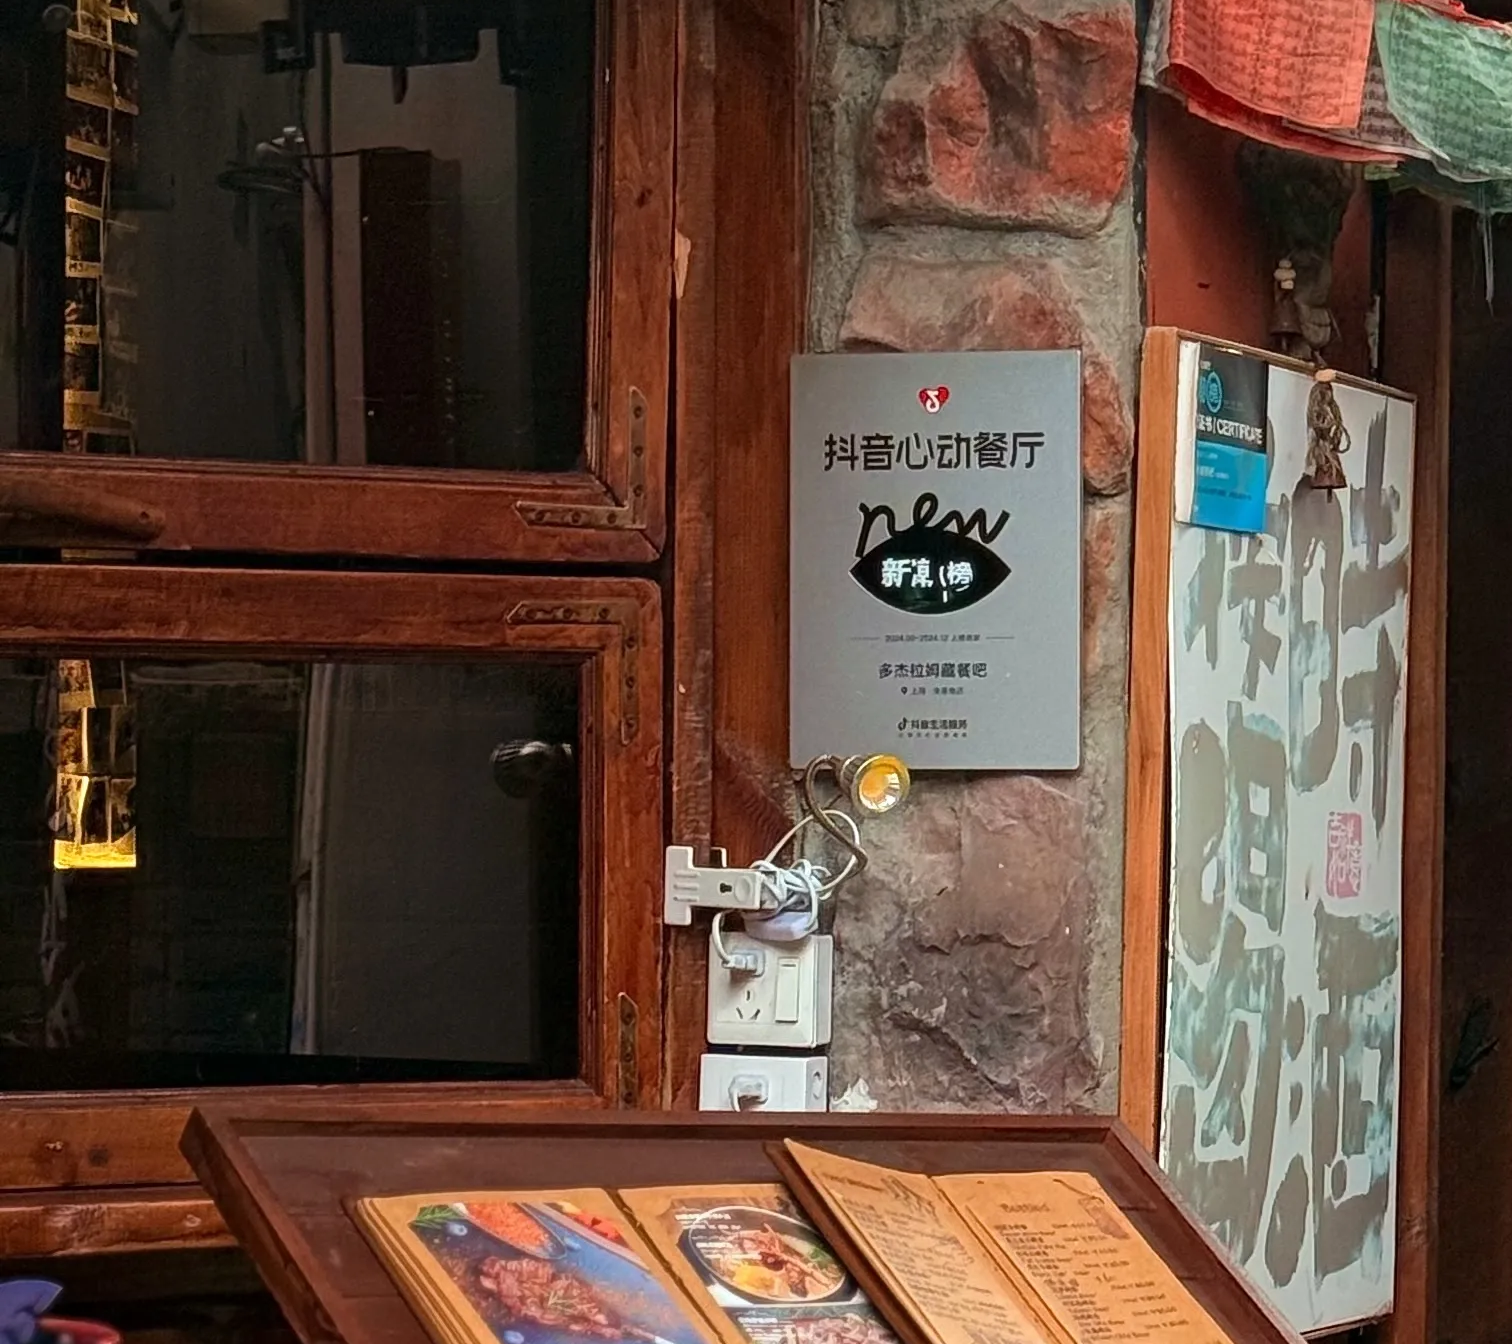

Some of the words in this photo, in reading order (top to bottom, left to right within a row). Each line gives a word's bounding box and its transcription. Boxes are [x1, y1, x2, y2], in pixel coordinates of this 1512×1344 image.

[823, 431, 1045, 472] 抖音心动餐厅
[855, 492, 1012, 558] new
